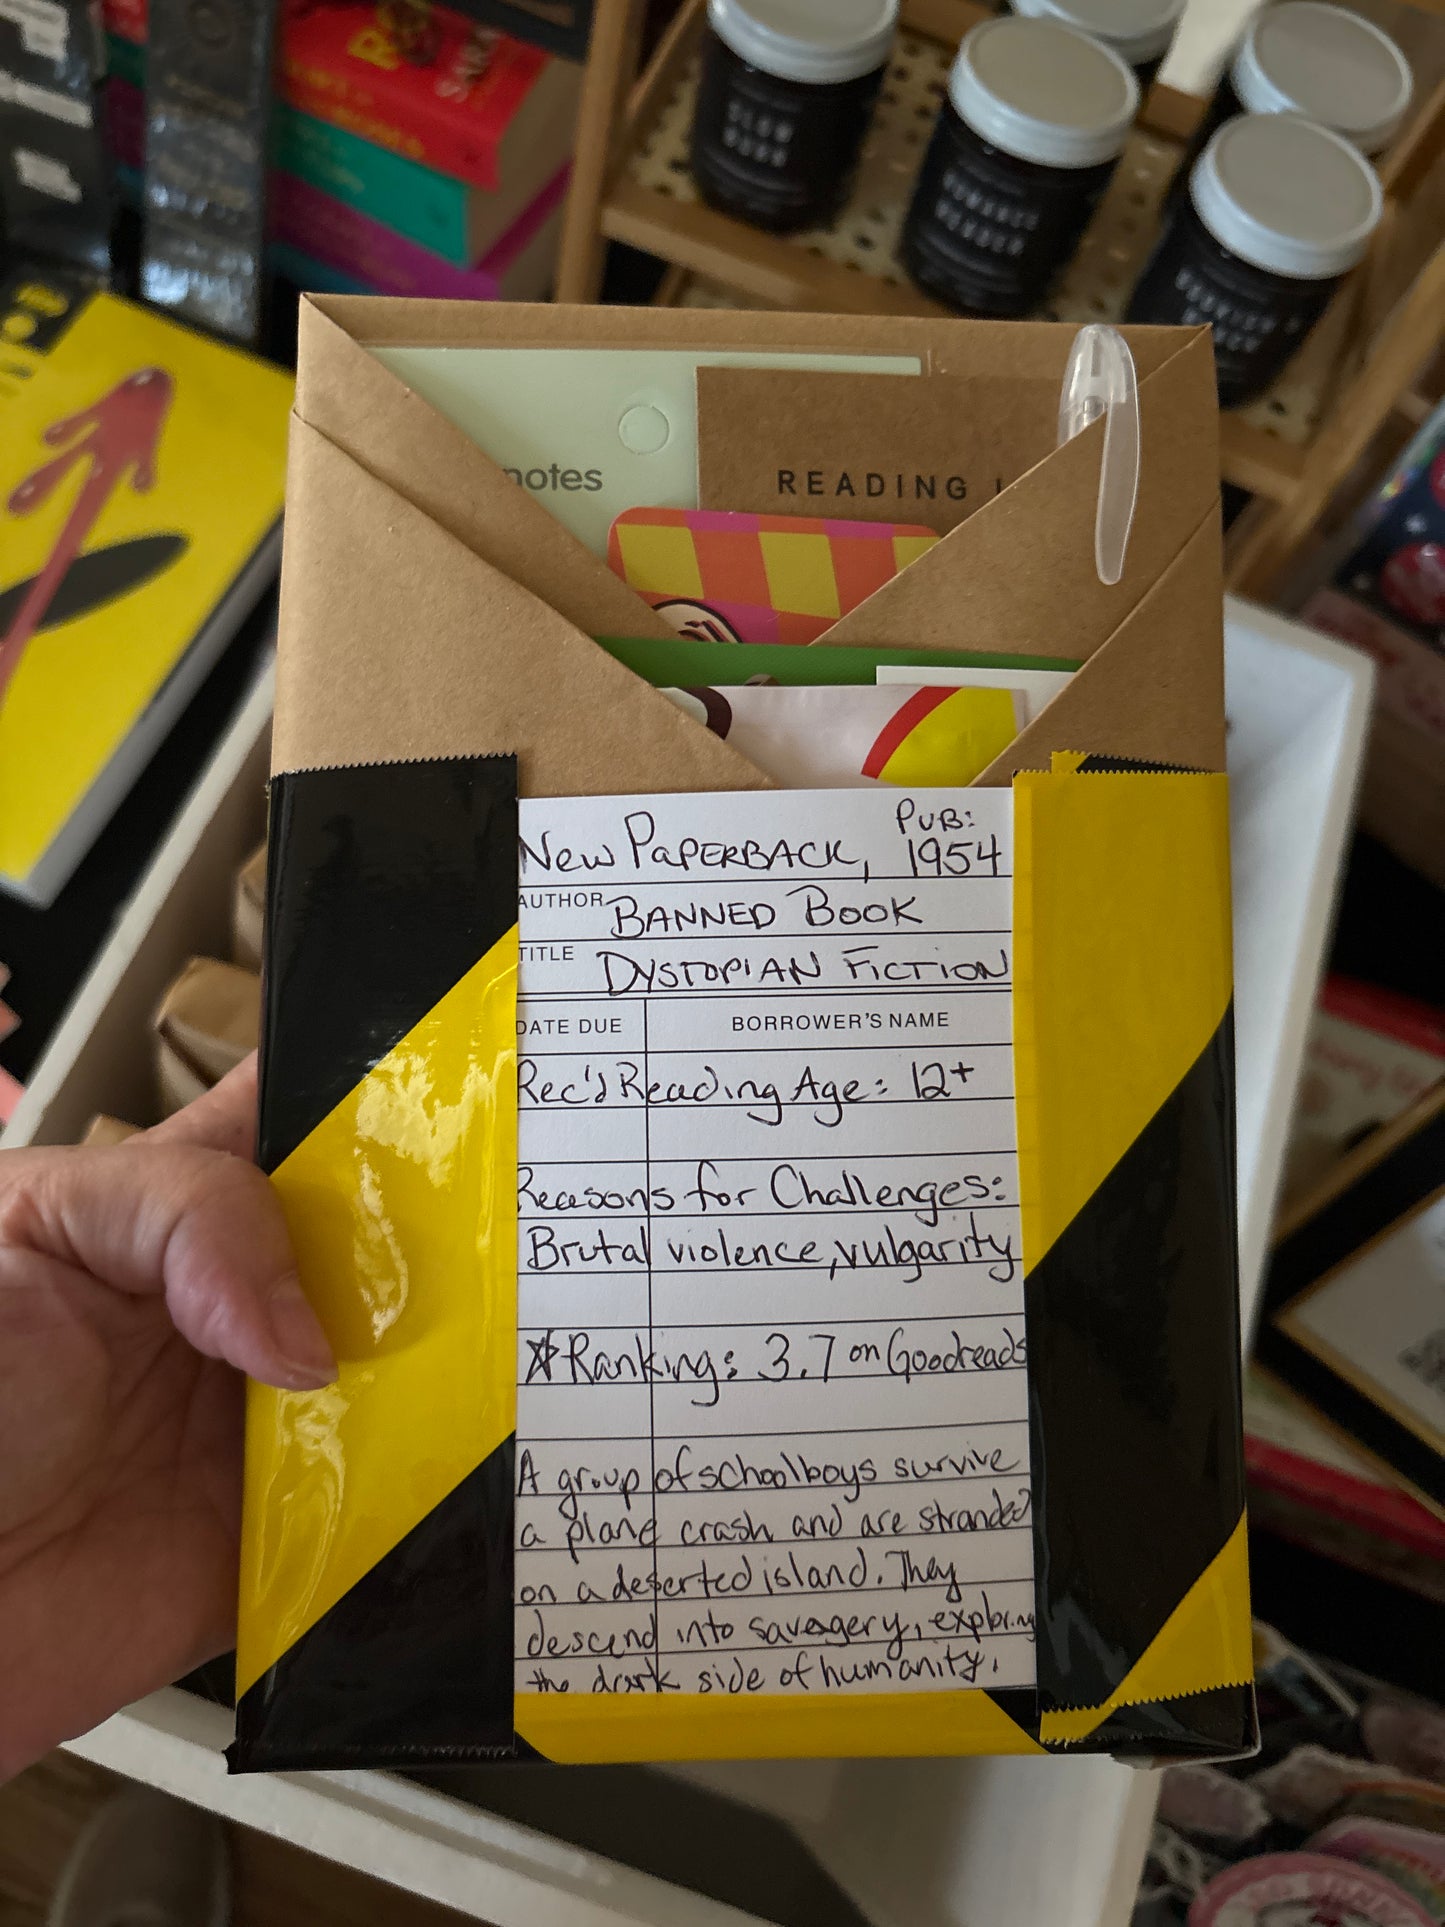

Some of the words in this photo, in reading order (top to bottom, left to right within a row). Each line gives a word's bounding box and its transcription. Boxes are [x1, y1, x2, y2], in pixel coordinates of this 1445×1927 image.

[502, 463, 603, 491] notes
[777, 469, 967, 500] READING
[519, 830, 616, 874] New
[906, 834, 1002, 877] 1954
[518, 892, 603, 909] AUTHOR
[605, 895, 777, 939] BANNED
[518, 946, 574, 962] TITLE
[596, 951, 822, 996] DYSTOPIAN
[516, 1019, 569, 1036] DATE
[579, 1018, 622, 1034] DUE
[732, 1013, 882, 1032] BORROWER'S
[889, 1012, 949, 1028] NAME
[616, 1065, 783, 1125] Reading
[911, 1060, 975, 1100] 12+
[517, 1166, 675, 1212] Reasons
[684, 1159, 757, 1210] for
[770, 1163, 1007, 1226] Challenges:
[527, 1225, 650, 1270] Brutal
[567, 1332, 738, 1407] Ranking:
[758, 1334, 836, 1383] 3.7
[850, 1344, 882, 1365] on
[887, 1326, 1026, 1384] Goodreads
[516, 1449, 540, 1497] A
[557, 1470, 641, 1519] group
[654, 1446, 693, 1494] of
[698, 1450, 878, 1503] schoolboys
[895, 1446, 1021, 1478] survive
[521, 1524, 546, 1547] a
[567, 1512, 660, 1564] plane
[680, 1514, 776, 1545] crash
[793, 1504, 841, 1538] and
[862, 1510, 907, 1536] are
[919, 1488, 1030, 1533] stranded
[521, 1583, 558, 1605] on
[578, 1580, 607, 1601] a
[612, 1556, 754, 1601] deserted
[763, 1547, 884, 1594] island.
[885, 1550, 962, 1603] They
[527, 1608, 657, 1659] descend
[677, 1611, 735, 1648] into
[750, 1615, 923, 1660] savagery,
[526, 1667, 570, 1693] the
[592, 1656, 681, 1693] dark
[699, 1660, 765, 1692] side
[779, 1651, 815, 1688] of
[819, 1647, 999, 1684] humanity.
